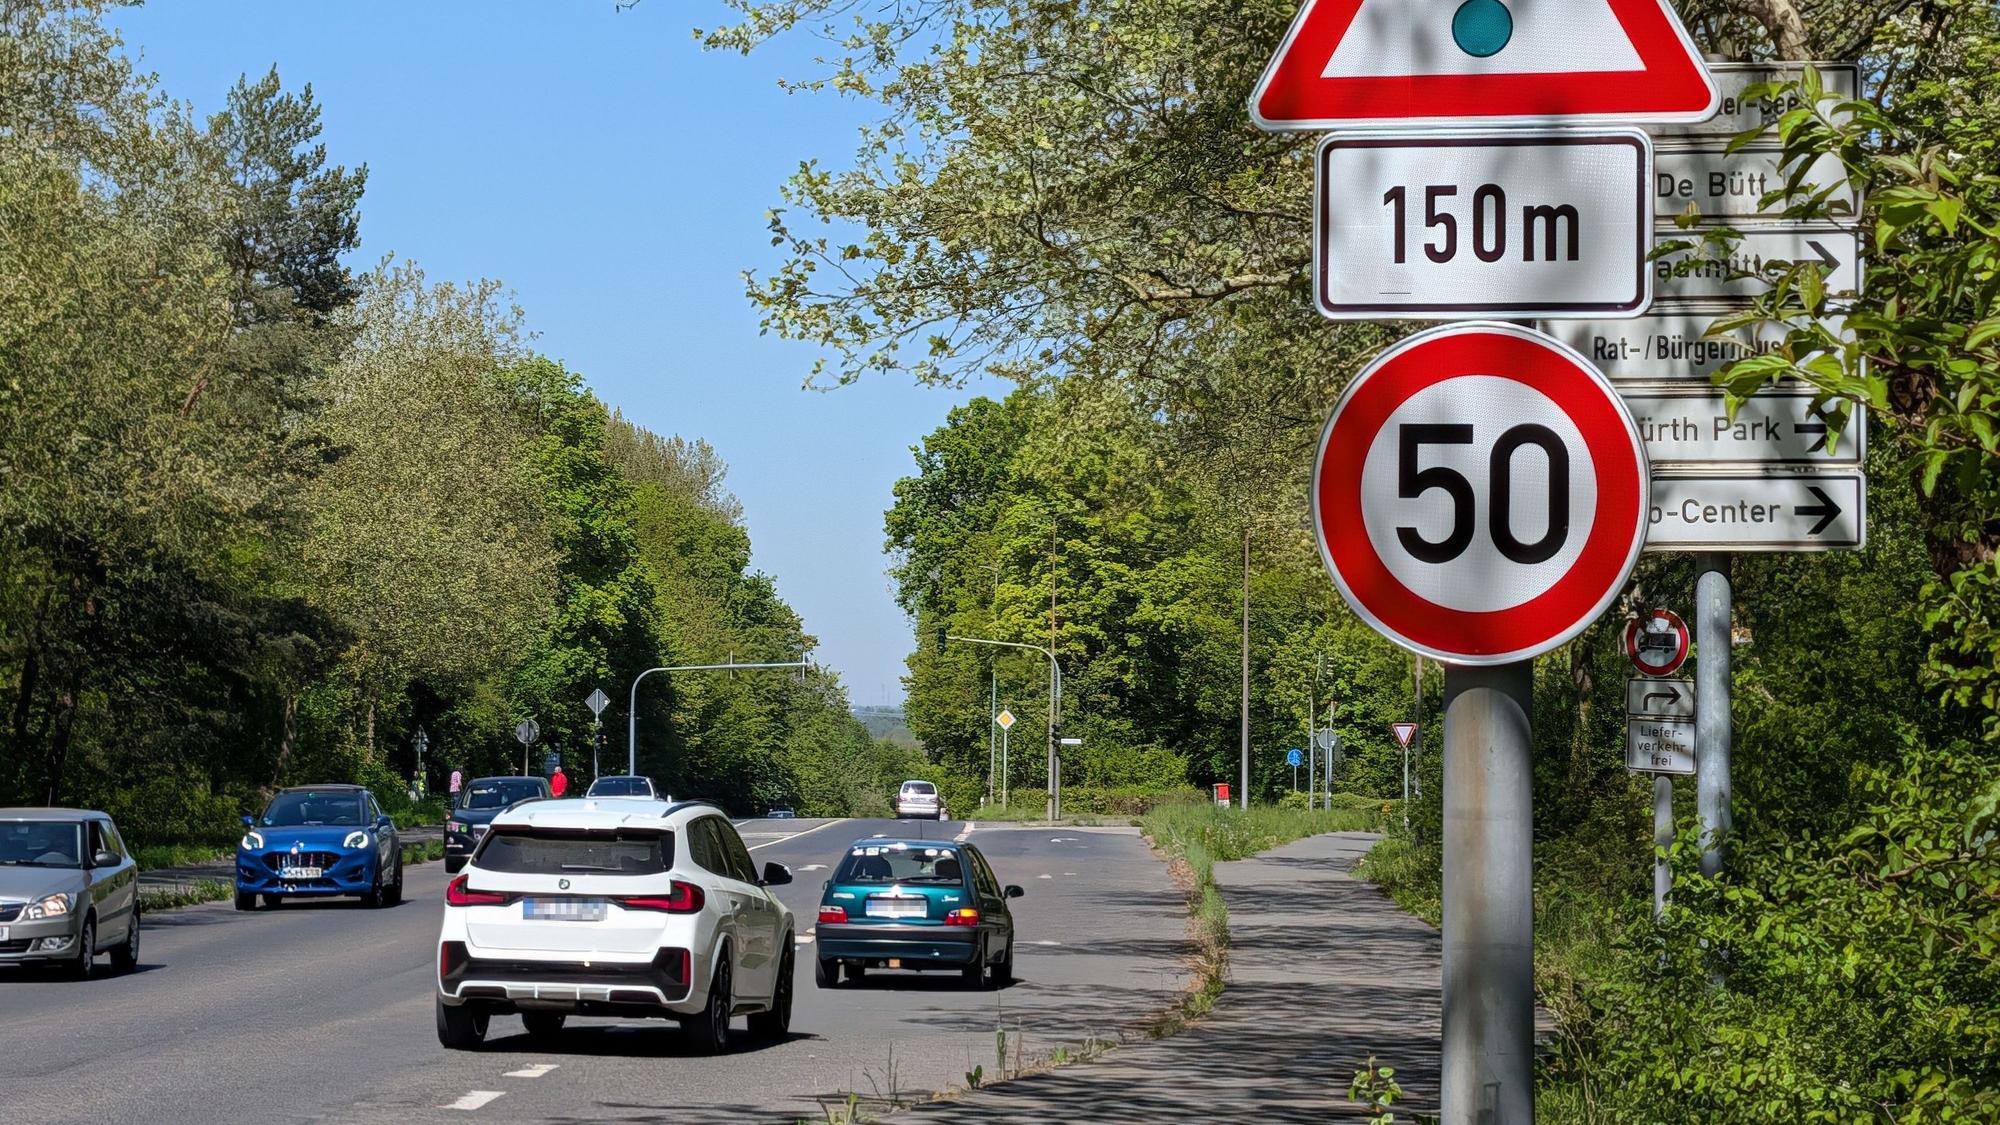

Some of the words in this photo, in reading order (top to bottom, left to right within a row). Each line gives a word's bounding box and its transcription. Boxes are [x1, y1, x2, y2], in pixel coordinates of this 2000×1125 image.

[1656, 172, 1693, 198] De
[1708, 171, 1767, 197] Bütt
[1639, 416, 1699, 442] ürth
[1713, 415, 1781, 441] Park
[1395, 422, 1570, 565] 50
[1649, 498, 1781, 524] o-Center
[1640, 725, 1683, 738] Liefer-
[1637, 740, 1686, 753] verkehr
[1650, 754, 1672, 766] frei
